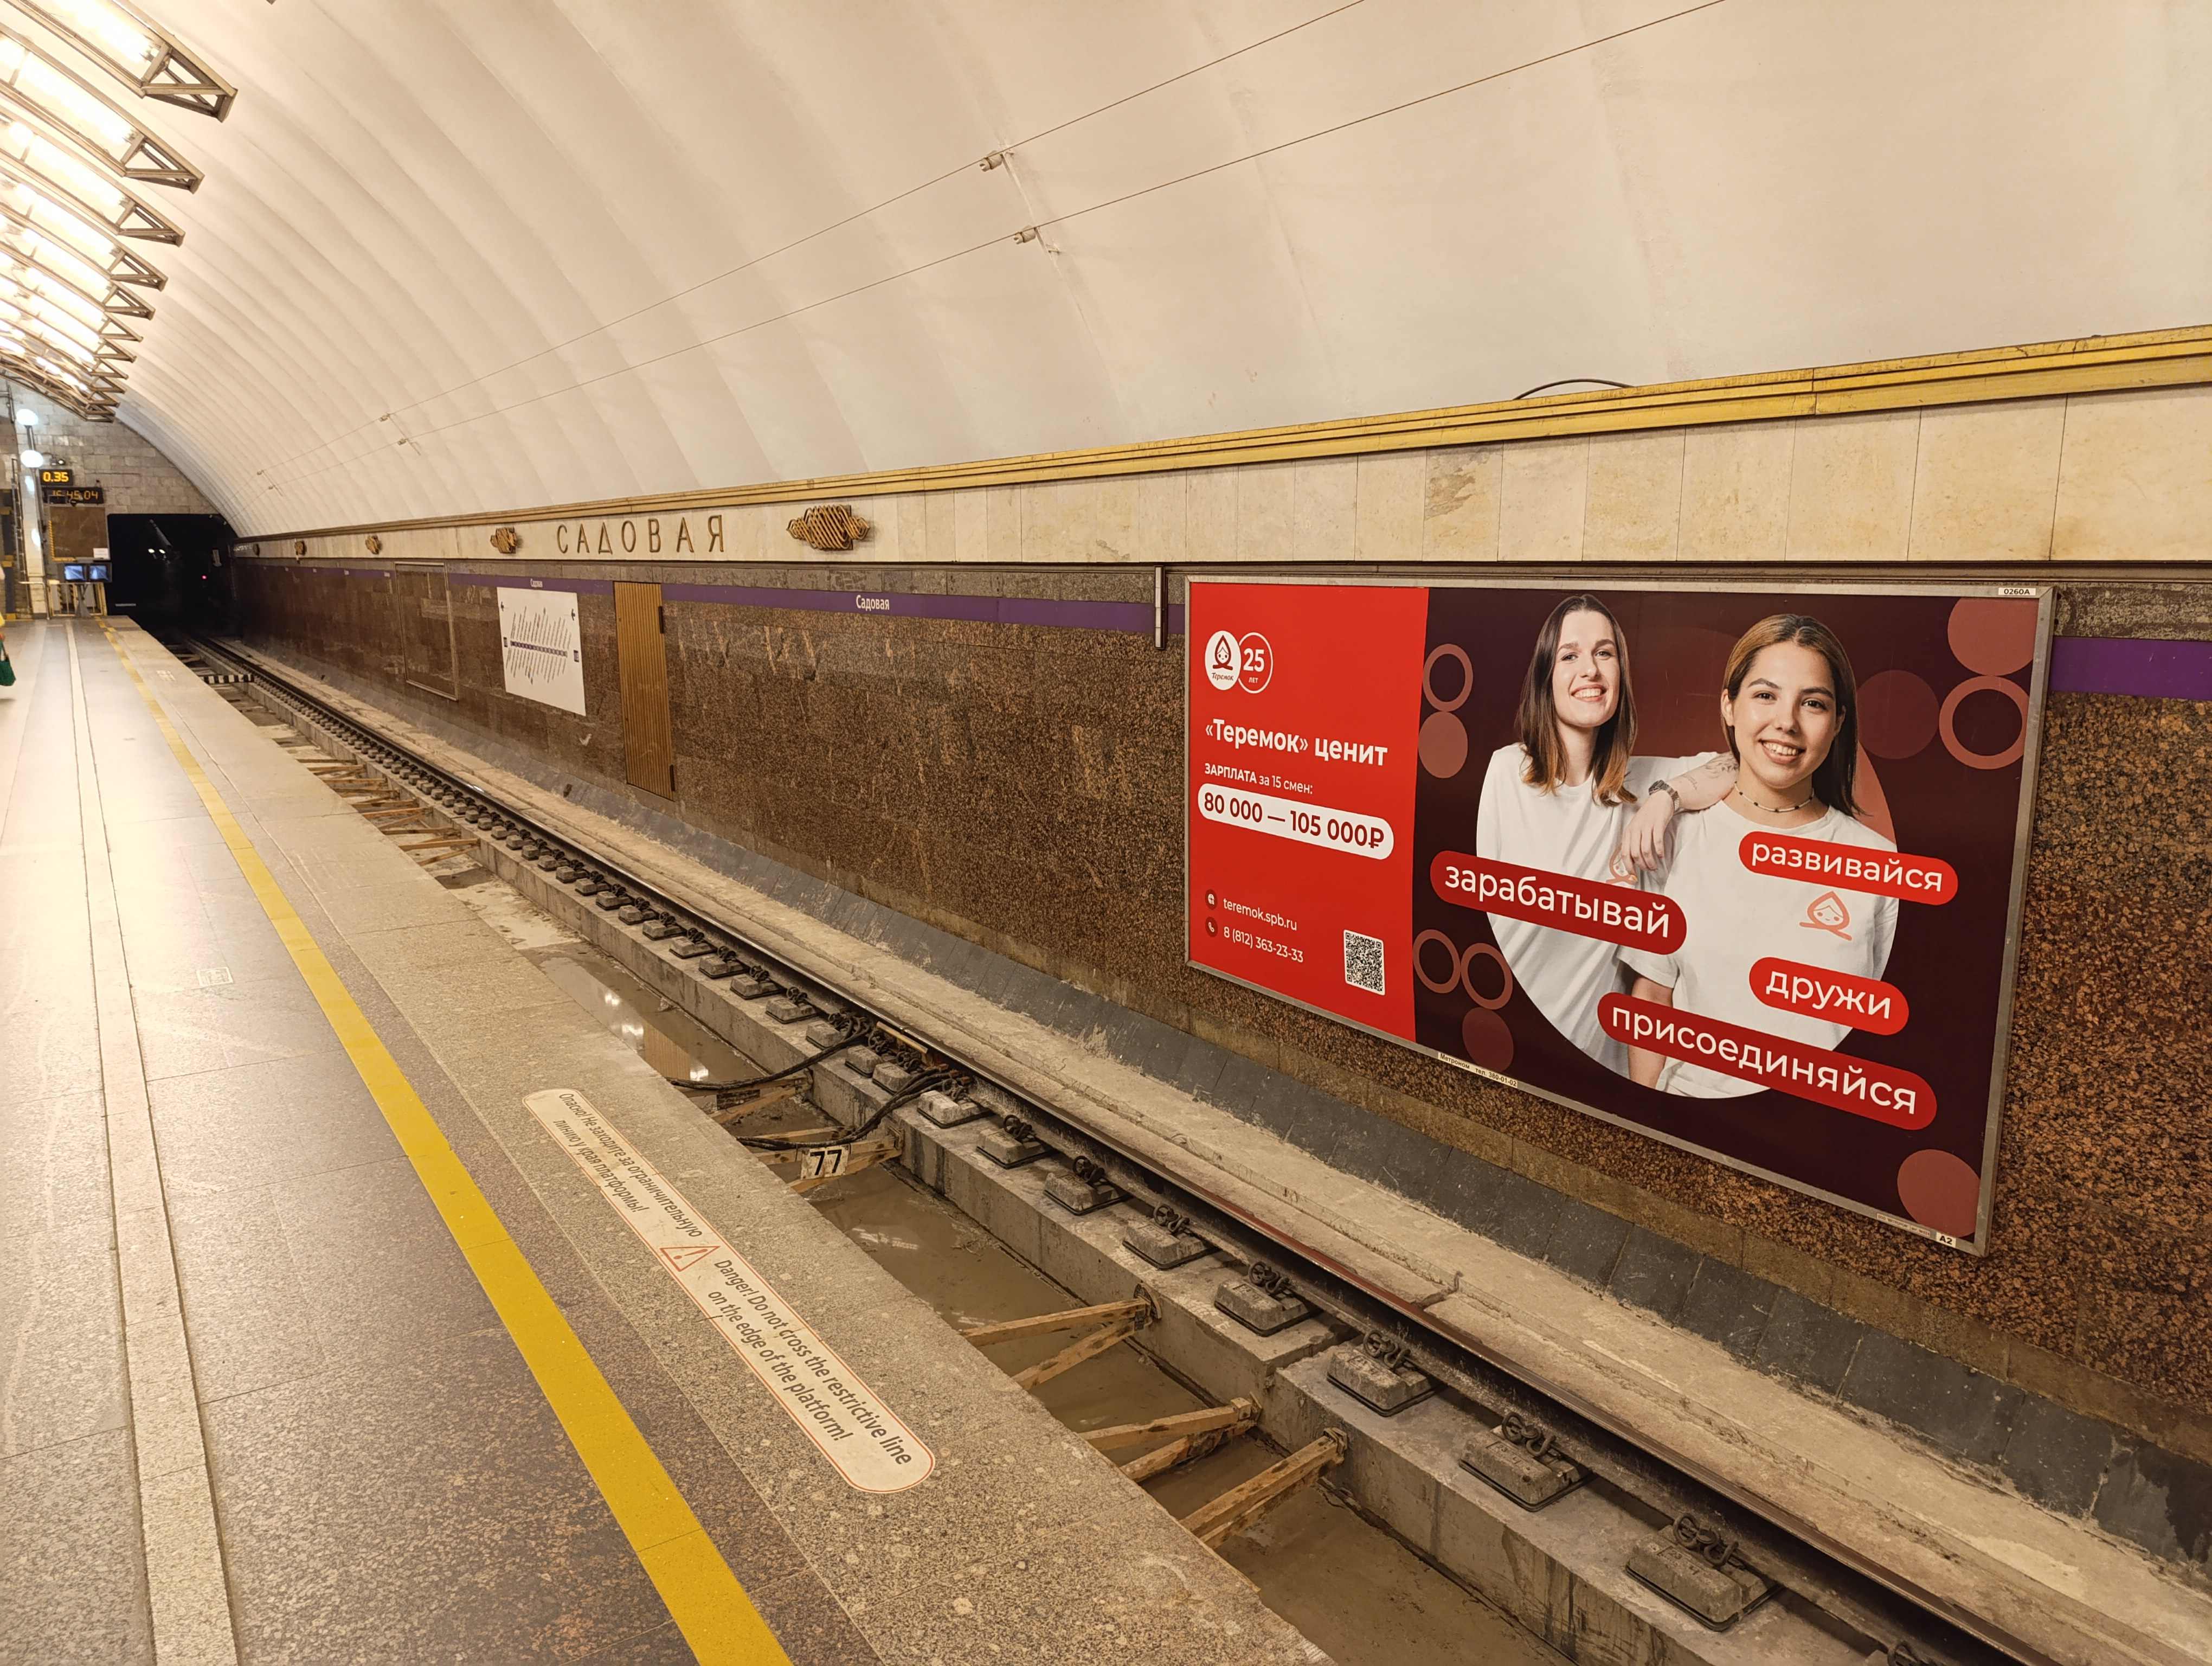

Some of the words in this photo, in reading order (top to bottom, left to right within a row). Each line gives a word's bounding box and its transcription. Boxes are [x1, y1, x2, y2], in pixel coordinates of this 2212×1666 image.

[43, 472, 69, 482] 0.35
[557, 515, 724, 554] САДОВАЯ
[856, 594, 889, 611] Садовая
[1243, 648, 1265, 672] 25
[1212, 672, 1234, 681] Теремок
[1205, 718, 1309, 753] «Теремок»
[1315, 738, 1388, 766] ценит
[1205, 762, 1257, 784] ЗАРПЛАТА
[1258, 775, 1270, 786] за
[1272, 776, 1282, 788] 15
[1284, 780, 1313, 794] смен:
[1204, 792, 1225, 814] 80
[1230, 798, 1263, 823] 000
[1290, 810, 1321, 836] 105
[1752, 842, 1943, 892] развивайся
[1223, 898, 1297, 931] teremok.spb.ru
[1445, 866, 1669, 938] зарабатывай
[1224, 926, 1230, 938] 8
[1232, 929, 1253, 949] (812)
[1256, 937, 1303, 963] 363-23-33
[1766, 971, 1891, 1020] дружи
[1440, 1053, 1470, 1069] Метроном
[1475, 1068, 1487, 1076] тел.
[1489, 1072, 1517, 1086] 380-01-02
[1612, 1006, 1917, 1115] присоединяйся
[559, 1093, 589, 1119] Опасно!
[581, 1117, 598, 1127] Не
[589, 1125, 626, 1157] заходите
[553, 1120, 581, 1143] линию
[576, 1146, 601, 1164] края
[594, 1164, 650, 1213] платформы!
[619, 1156, 634, 1166] за
[810, 1149, 842, 1175] 77
[628, 1165, 703, 1237] ограничительную
[708, 1291, 728, 1305] on
[720, 1304, 743, 1323] the
[736, 1322, 767, 1349] edge
[714, 1259, 760, 1297] Danger!
[747, 1295, 768, 1311] Do
[761, 1310, 788, 1330] not
[779, 1329, 812, 1357] cross
[805, 1356, 830, 1377] the
[822, 1377, 887, 1439] restrictive
[879, 1436, 912, 1465] line
[760, 1349, 785, 1362] of
[771, 1361, 798, 1383] the
[783, 1382, 854, 1441] platform!
